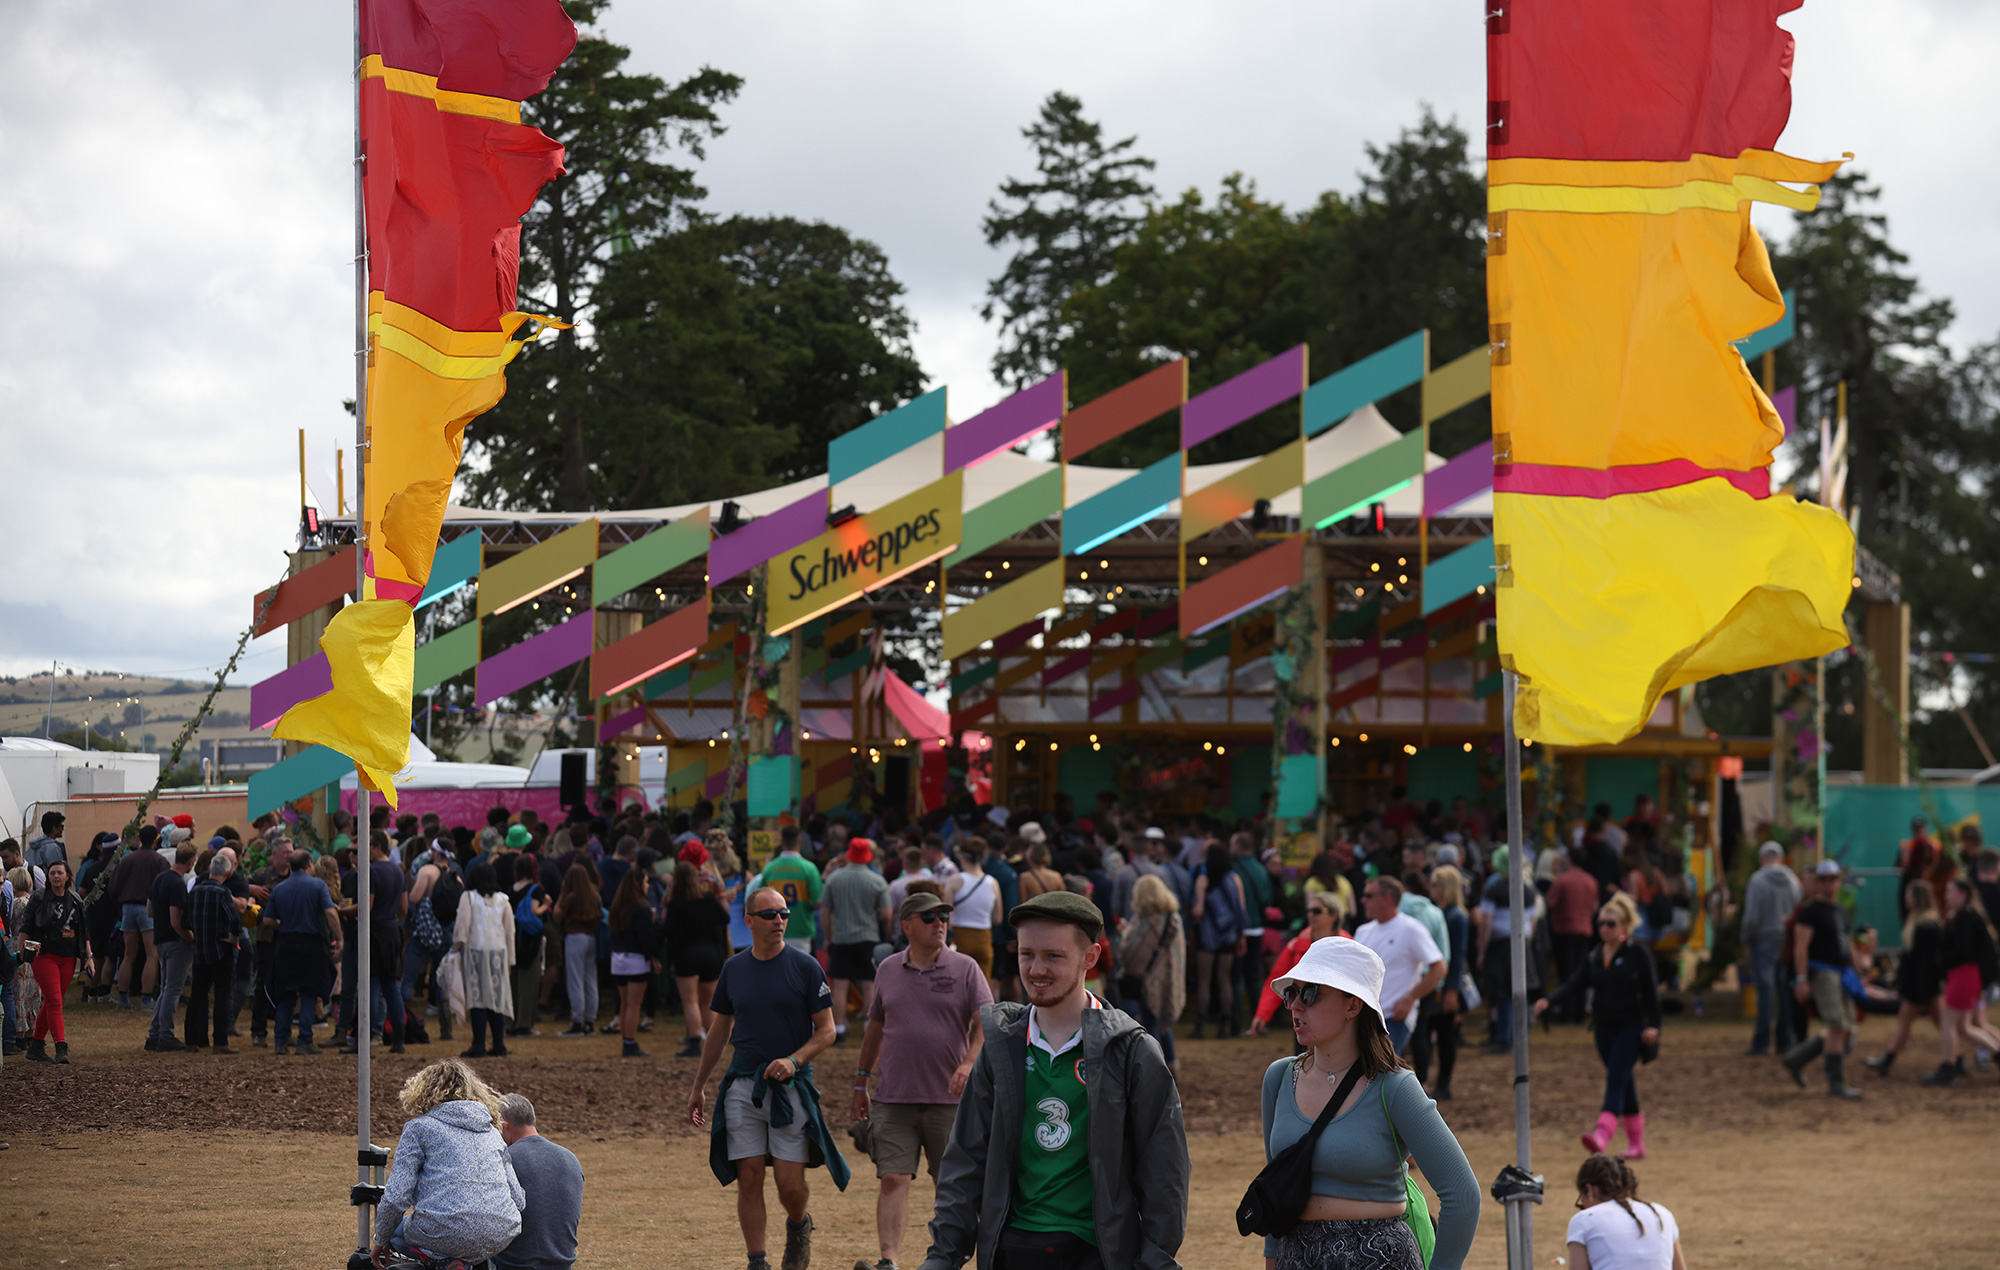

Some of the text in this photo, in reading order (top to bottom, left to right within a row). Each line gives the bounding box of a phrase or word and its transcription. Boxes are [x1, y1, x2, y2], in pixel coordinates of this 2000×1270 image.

[789, 508, 940, 601] Schweppes
[753, 834, 770, 848] NO
[783, 883, 798, 907] 9
[1035, 1097, 1072, 1152] 3
